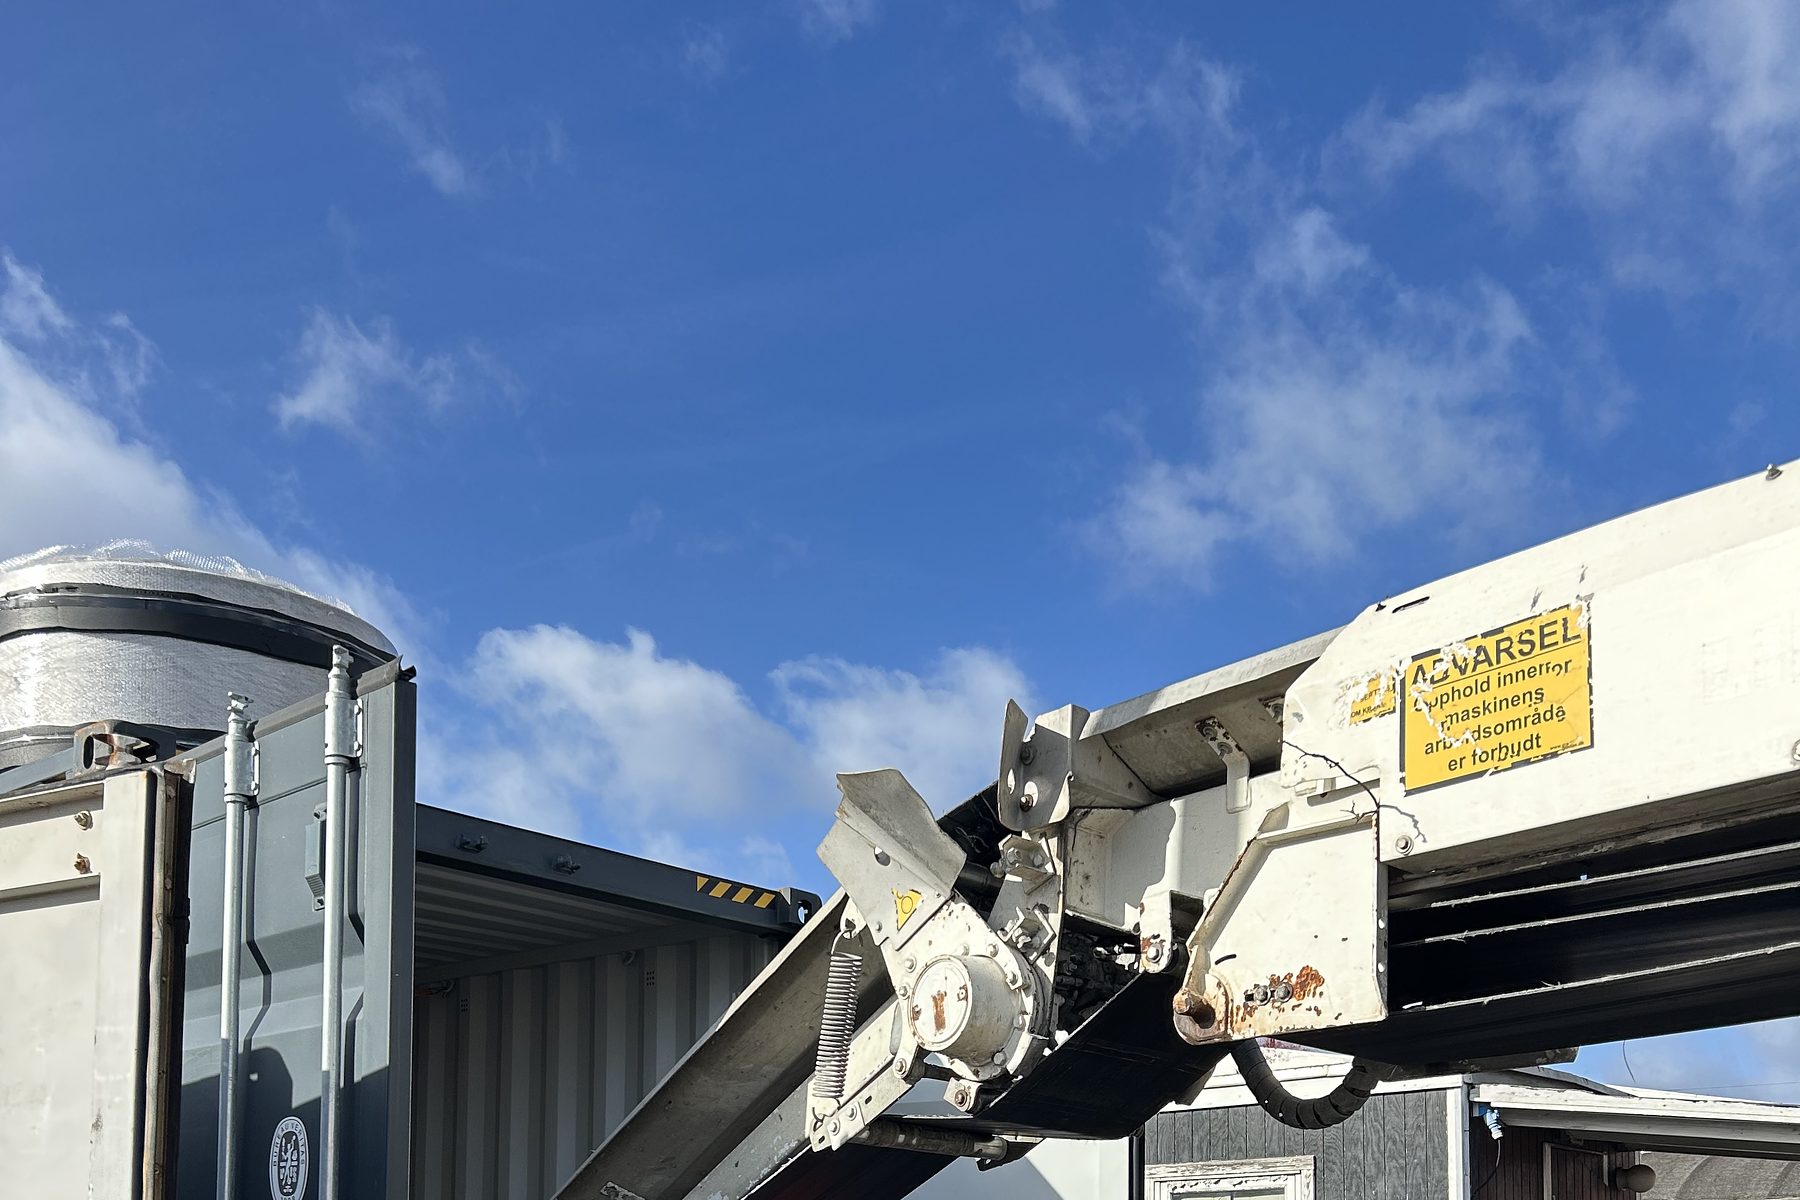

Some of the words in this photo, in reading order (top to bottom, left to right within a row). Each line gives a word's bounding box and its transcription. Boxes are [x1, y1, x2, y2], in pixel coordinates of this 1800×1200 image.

[1412, 617, 1581, 685] ADVARSEL
[1425, 706, 1566, 755] arbdsområde
[1441, 687, 1545, 733] maskinens
[1448, 756, 1466, 771] er
[1471, 732, 1542, 766] forbudt
